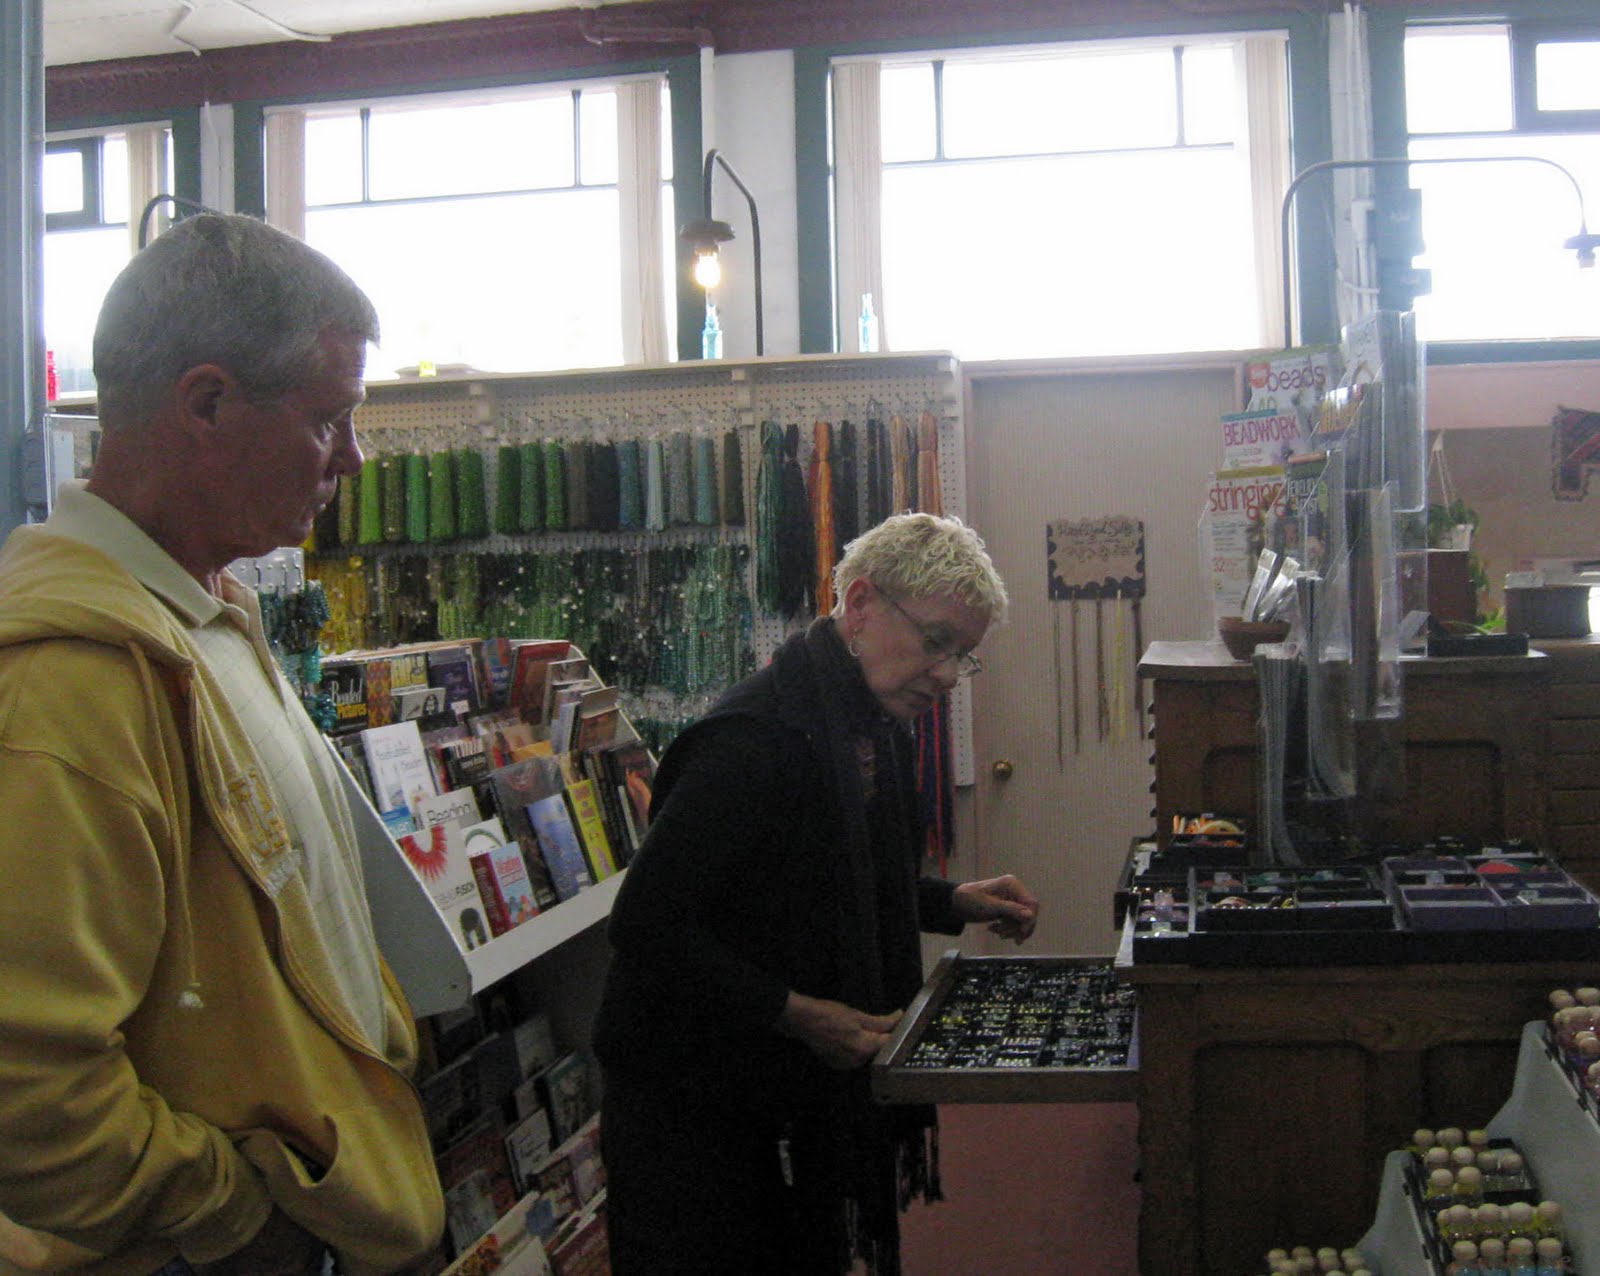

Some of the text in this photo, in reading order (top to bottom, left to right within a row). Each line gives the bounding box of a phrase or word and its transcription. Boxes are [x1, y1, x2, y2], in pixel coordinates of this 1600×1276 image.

[1267, 354, 1326, 391] beads
[1223, 416, 1299, 447] BEADWORK
[1209, 479, 1289, 520] stringing
